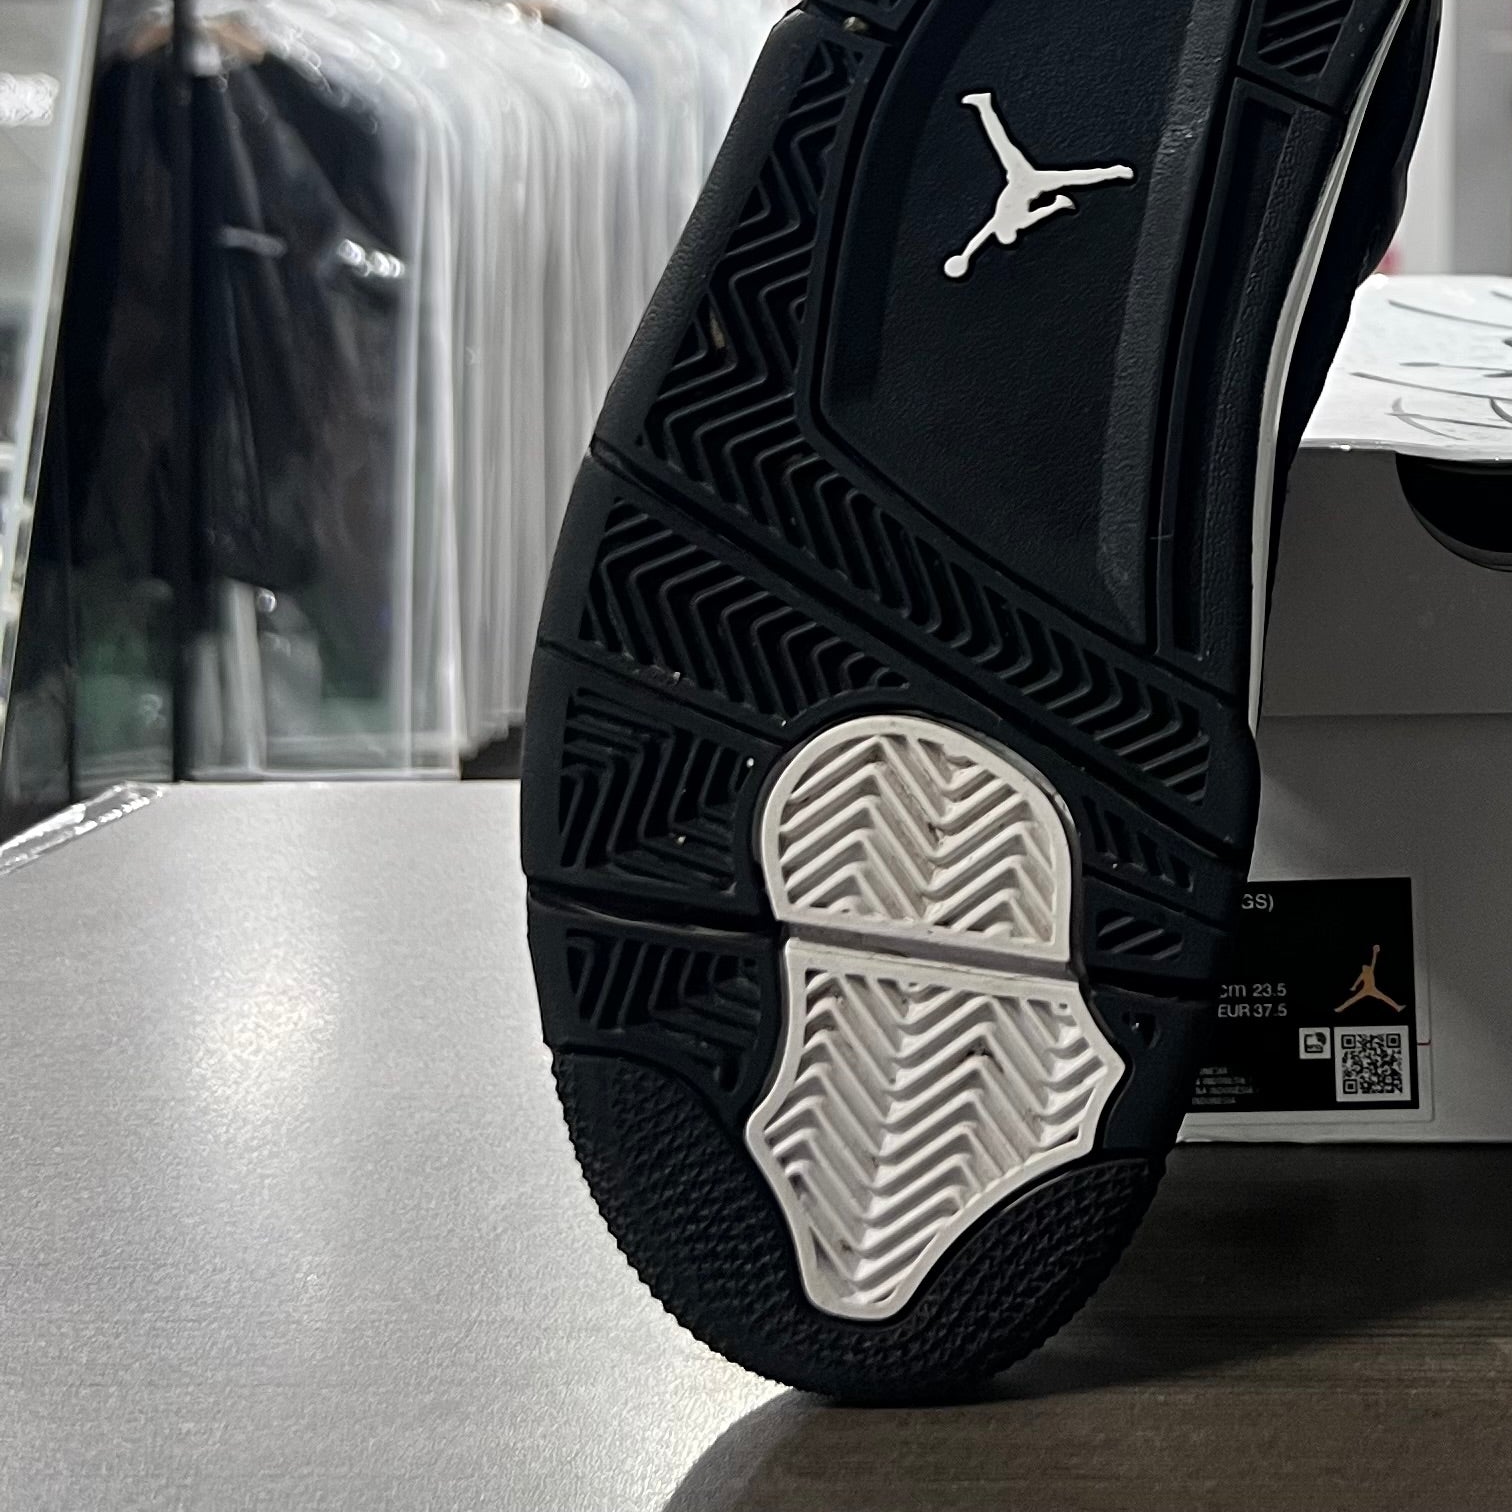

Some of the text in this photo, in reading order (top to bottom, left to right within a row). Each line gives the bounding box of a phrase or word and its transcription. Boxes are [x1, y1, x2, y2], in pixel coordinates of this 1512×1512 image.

[1252, 982, 1287, 997] 23.5
[1217, 1002, 1287, 1018] EUR 37.5
